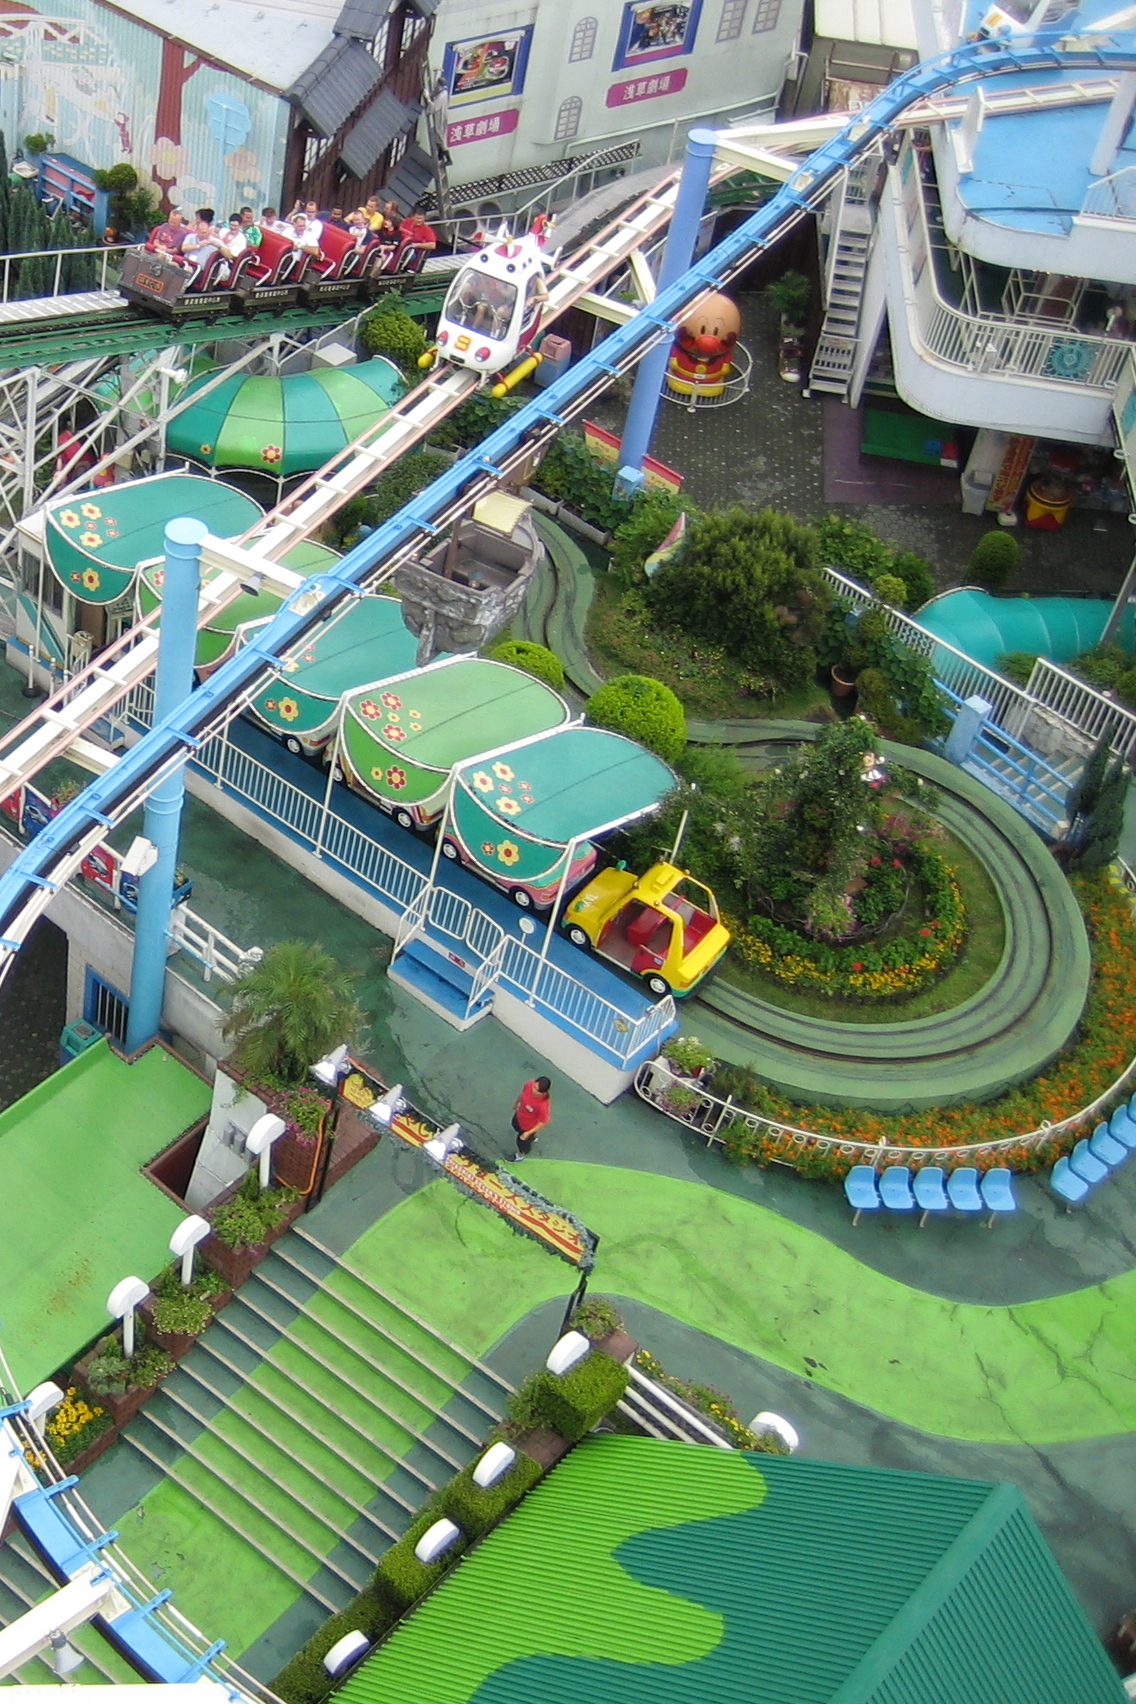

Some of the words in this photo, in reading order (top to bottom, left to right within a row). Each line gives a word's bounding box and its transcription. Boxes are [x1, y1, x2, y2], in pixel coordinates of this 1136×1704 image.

[622, 75, 671, 101] 浅草劇場
[449, 116, 501, 143] 浅草劇場
